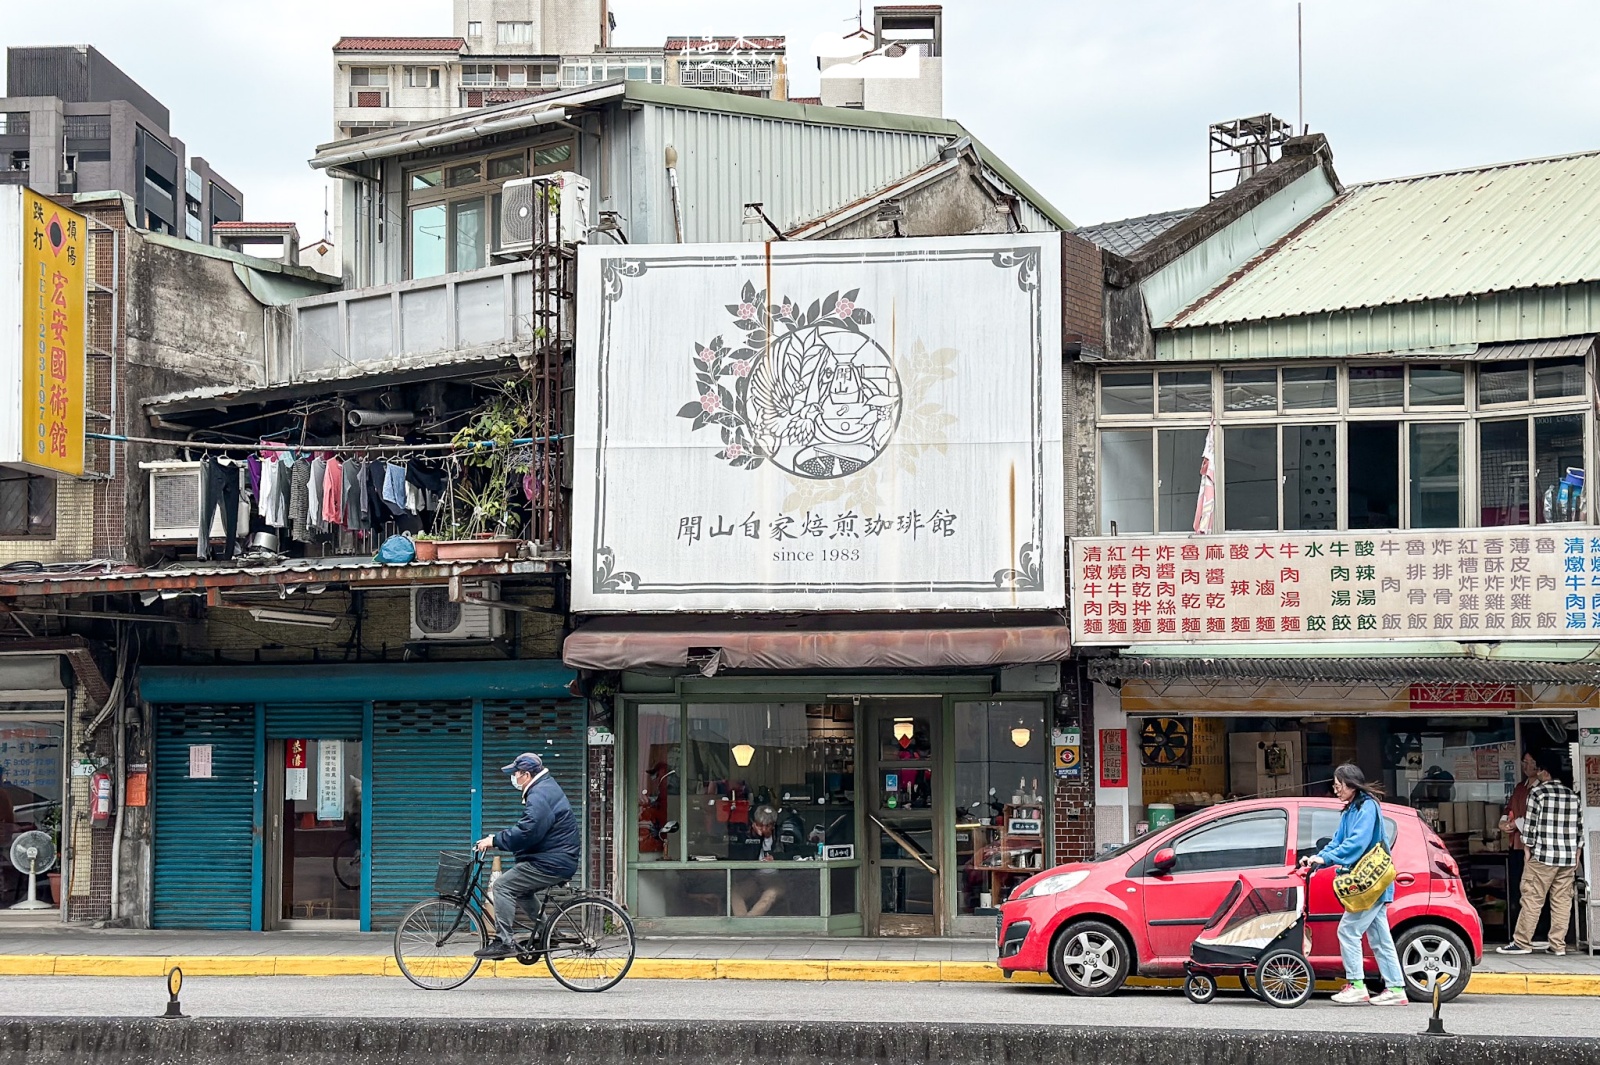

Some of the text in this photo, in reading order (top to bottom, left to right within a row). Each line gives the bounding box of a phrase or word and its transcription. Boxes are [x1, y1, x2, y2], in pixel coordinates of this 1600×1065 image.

[32, 201, 45, 251] 跌打
[66, 218, 77, 266] 損傷
[49, 270, 69, 459] 宏安國術館
[677, 508, 958, 546] 聞山自家焙煎珈琲館
[772, 549, 860, 562] since 1983
[1083, 547, 1102, 634] 清燉牛肉麵
[1108, 546, 1126, 634] 紅燒牛肉麵
[1132, 546, 1151, 633] 牛肉乾拌麵
[1157, 546, 1176, 633] 炸醬肉絲麵
[1181, 545, 1200, 633] 魯肉乾麵
[1206, 544, 1225, 633] 麻醬乾麵
[1230, 544, 1250, 632] 酸辣麵
[1280, 543, 1300, 632] 牛肉湯麵
[1305, 542, 1326, 631] 水餃
[1330, 541, 1351, 630] 牛肉湯餃
[1355, 540, 1376, 630] 酸辣湯餃
[1381, 540, 1401, 629] 牛肉飯
[1406, 540, 1427, 629] 魯排骨飯
[1432, 539, 1453, 629] 炸排骨飯
[1484, 538, 1505, 629] 香酥炸雞飯
[1510, 538, 1531, 628] 薄皮炸雞飯
[1536, 538, 1556, 628] 魯肉飯
[1565, 537, 1586, 628] 清燉牛肉湯
[600, 734, 610, 743] 17
[1064, 735, 1075, 744] 19
[1335, 860, 1375, 888] POCKET
